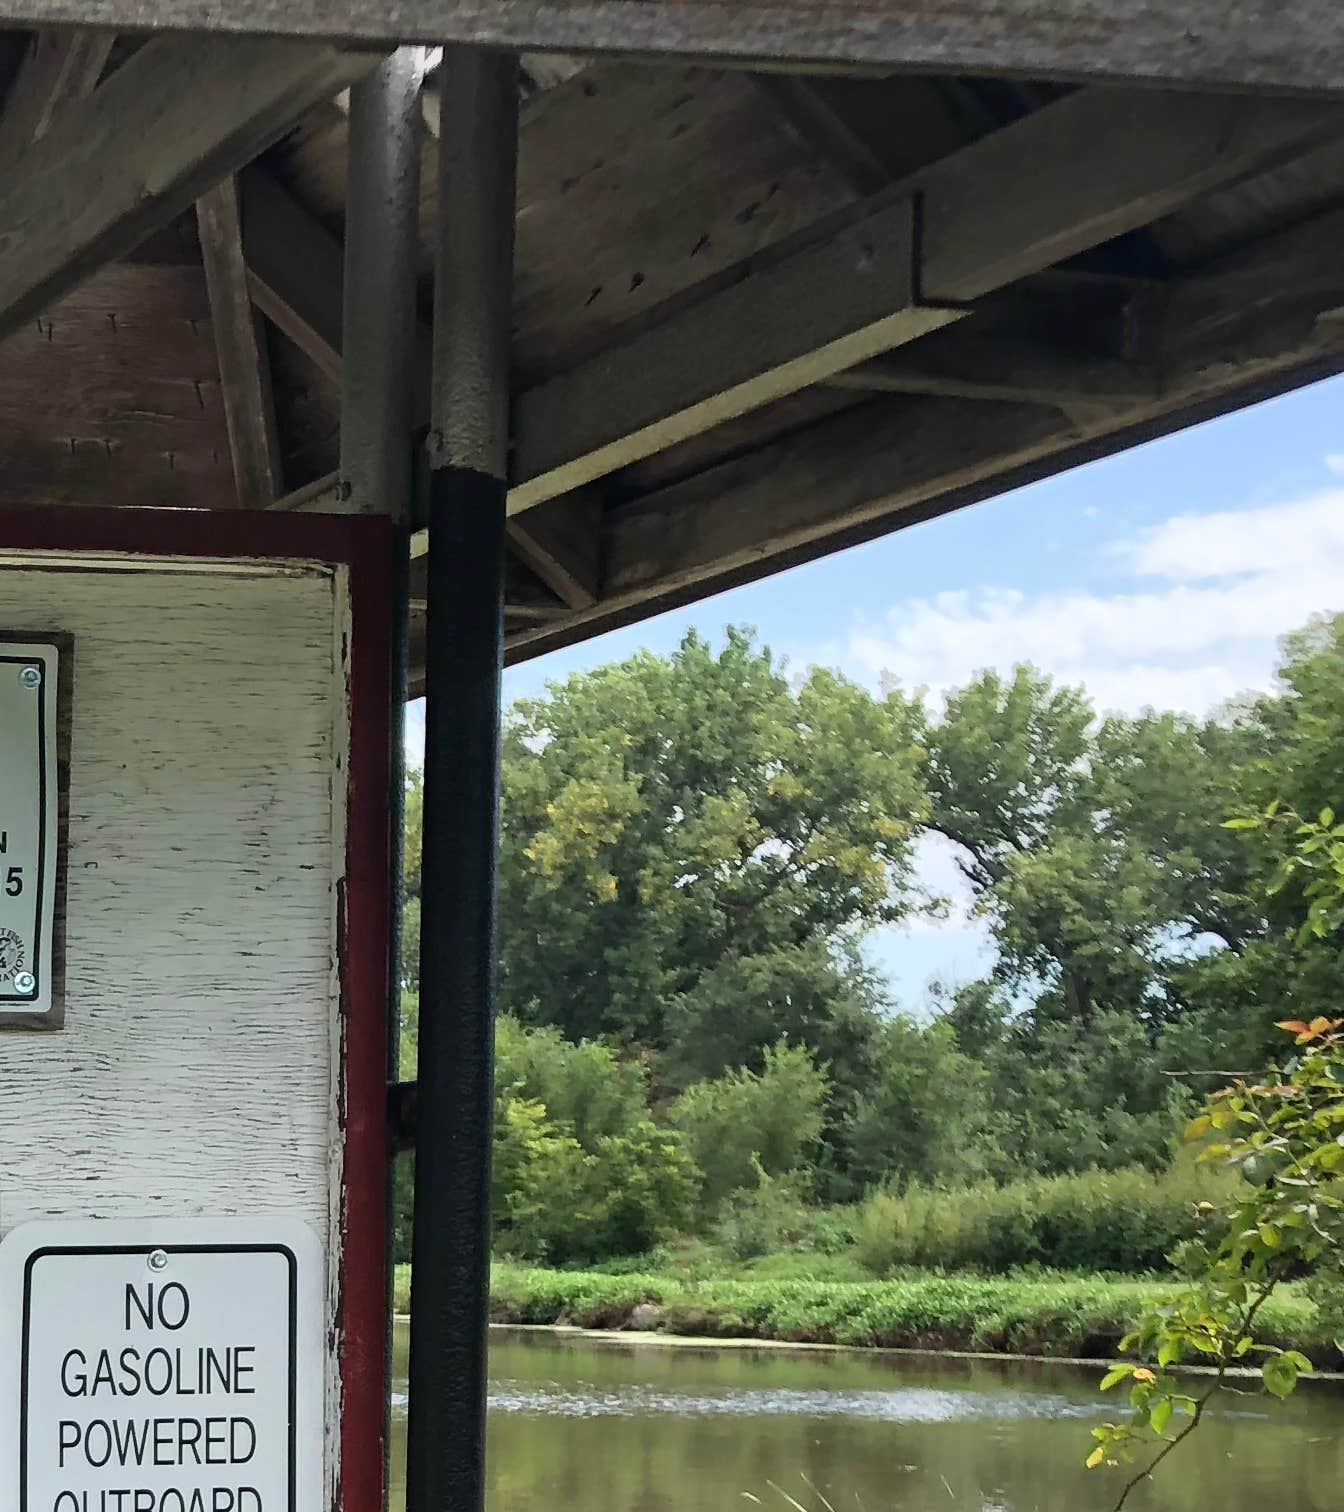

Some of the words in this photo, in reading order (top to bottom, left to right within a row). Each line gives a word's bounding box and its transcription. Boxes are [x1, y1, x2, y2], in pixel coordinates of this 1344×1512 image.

[125, 1282, 189, 1331] NO
[60, 1347, 255, 1397] GASOLINE
[59, 1417, 256, 1468] POWERED
